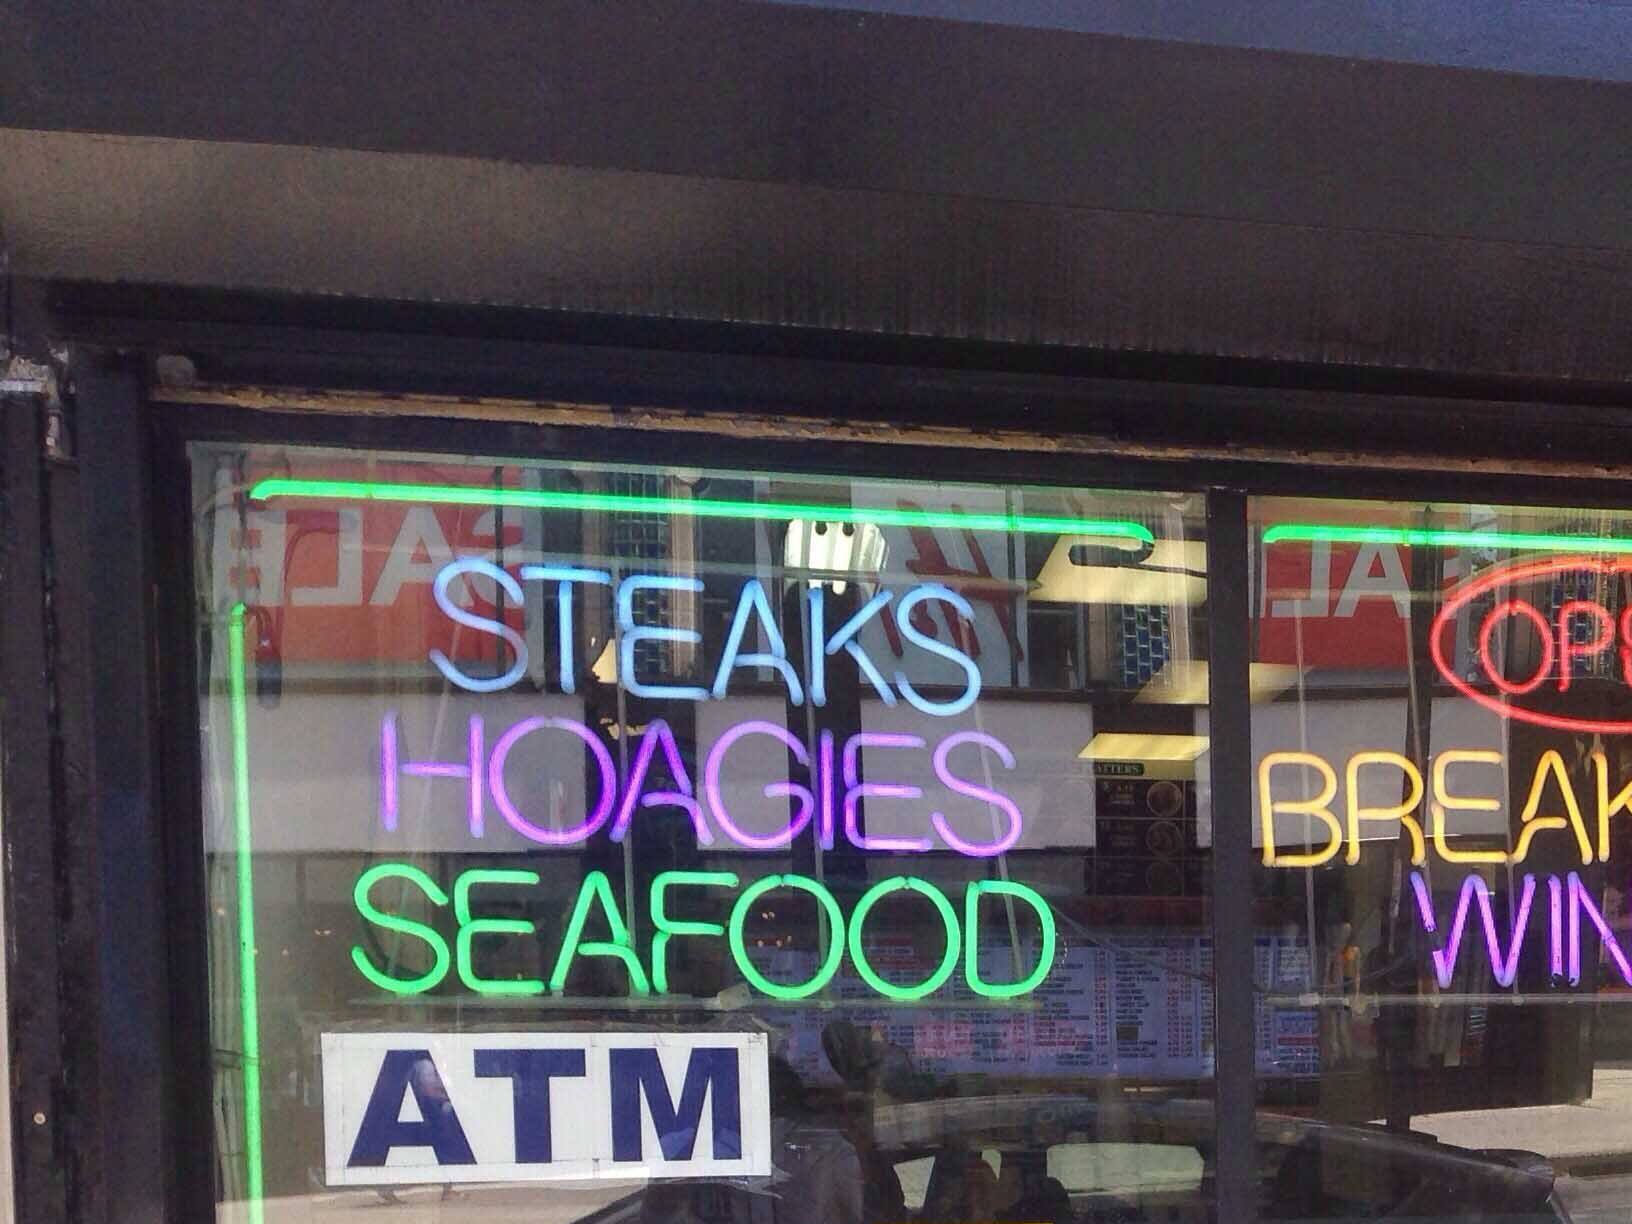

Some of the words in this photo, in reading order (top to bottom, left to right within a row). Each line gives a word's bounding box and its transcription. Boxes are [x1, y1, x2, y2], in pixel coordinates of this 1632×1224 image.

[430, 556, 982, 716] STEAKS
[381, 712, 1025, 858] HOAGIES
[351, 864, 1057, 1000] SEAFOOD
[347, 1046, 742, 1168] ATM
